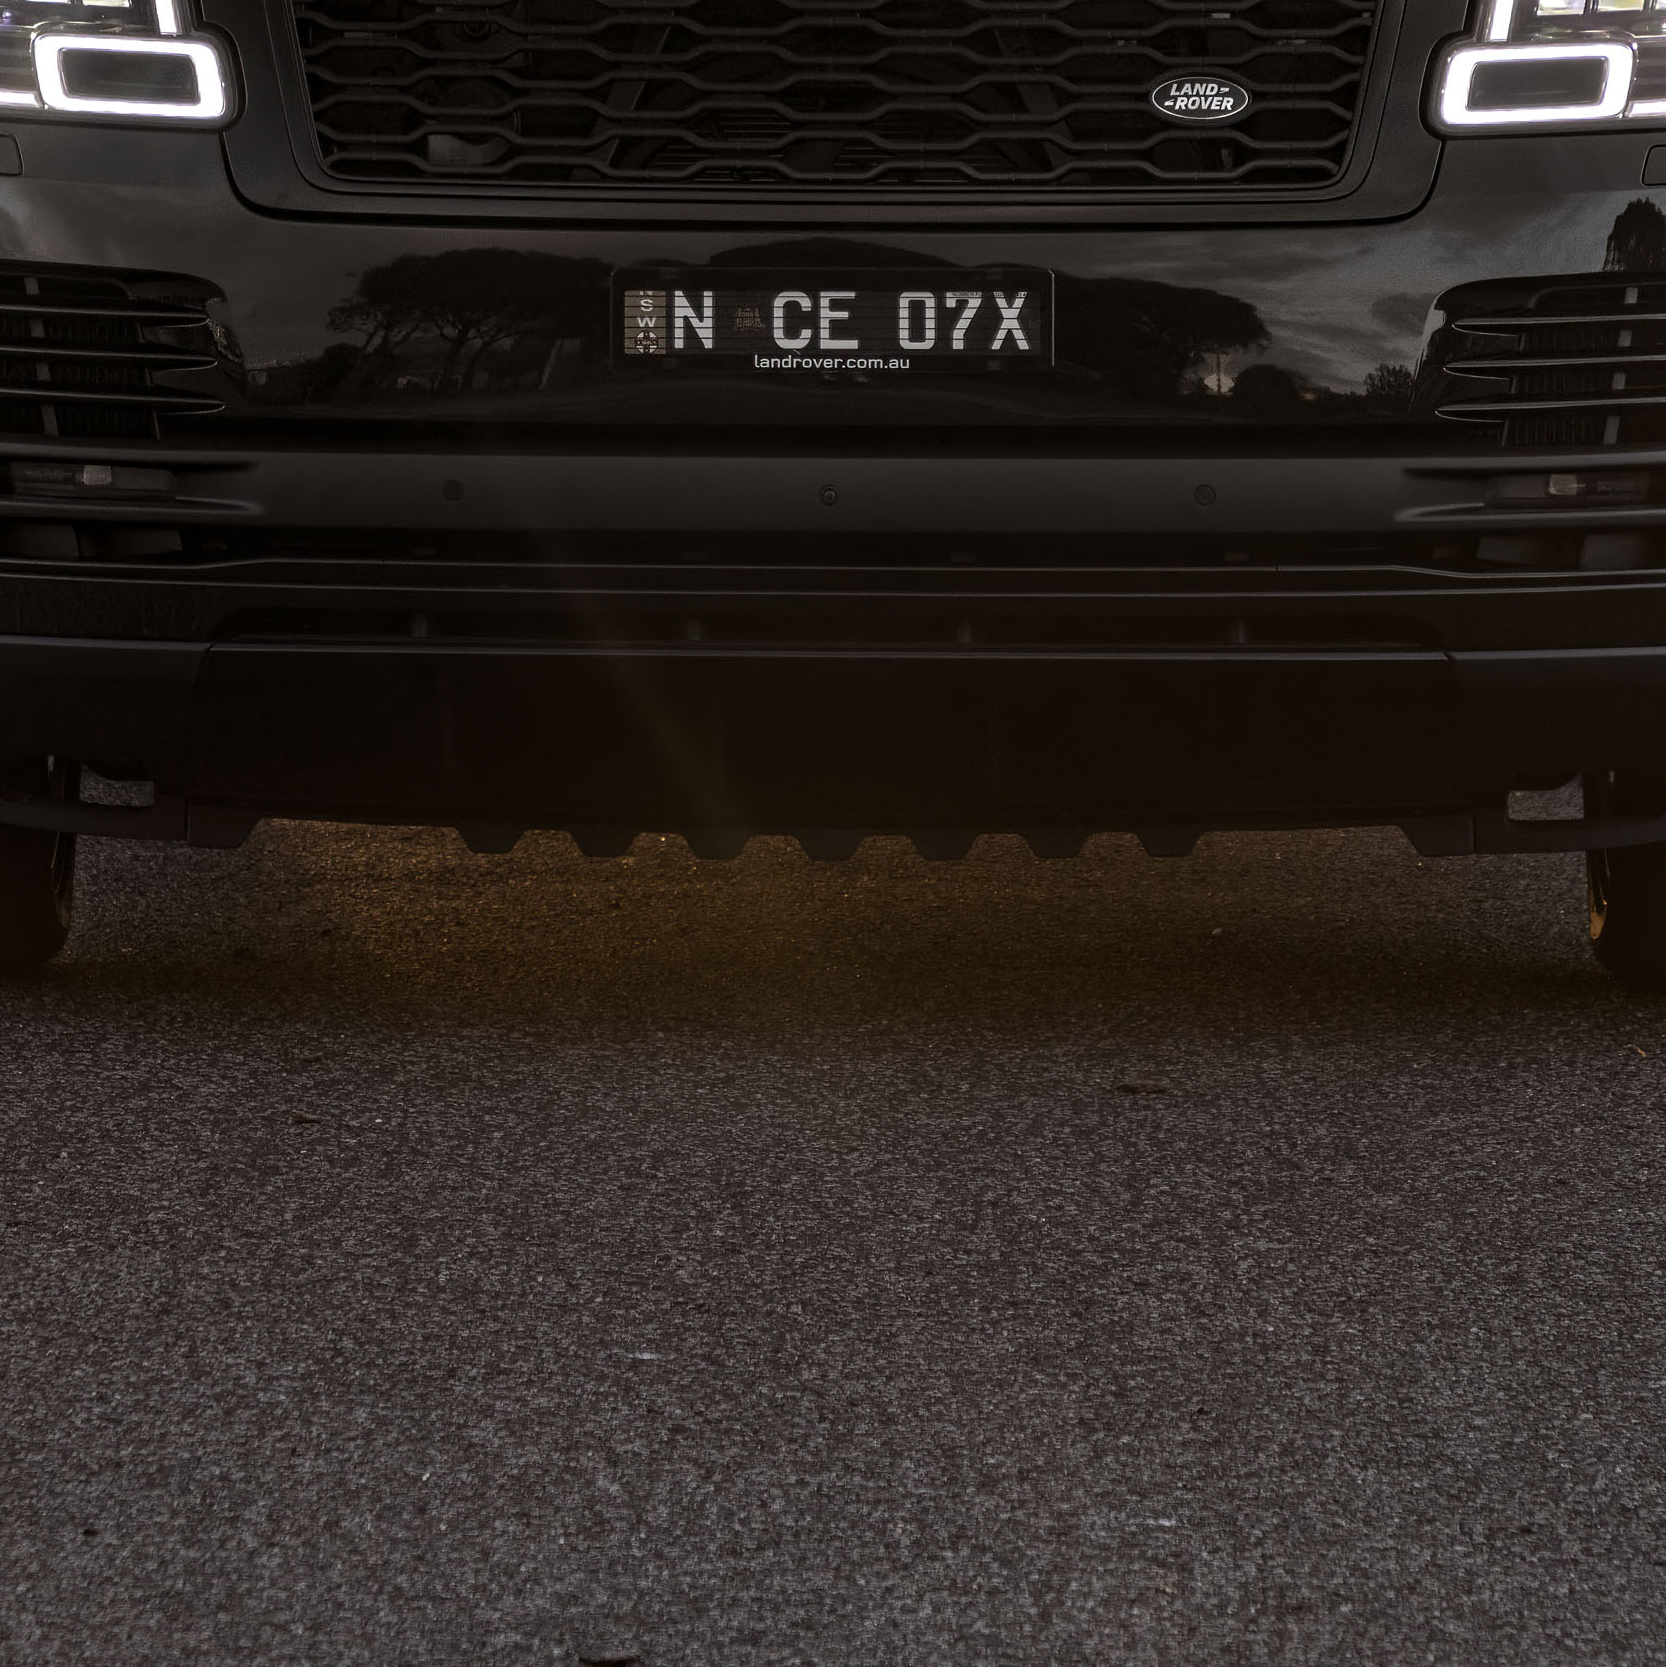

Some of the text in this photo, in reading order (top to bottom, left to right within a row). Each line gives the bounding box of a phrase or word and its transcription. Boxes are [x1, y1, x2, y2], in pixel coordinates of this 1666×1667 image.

[1170, 83, 1219, 96] LAND
[1174, 96, 1234, 111] ROVER
[674, 290, 713, 349] N
[773, 290, 859, 350] CE
[754, 354, 910, 369] landrover.com.au
